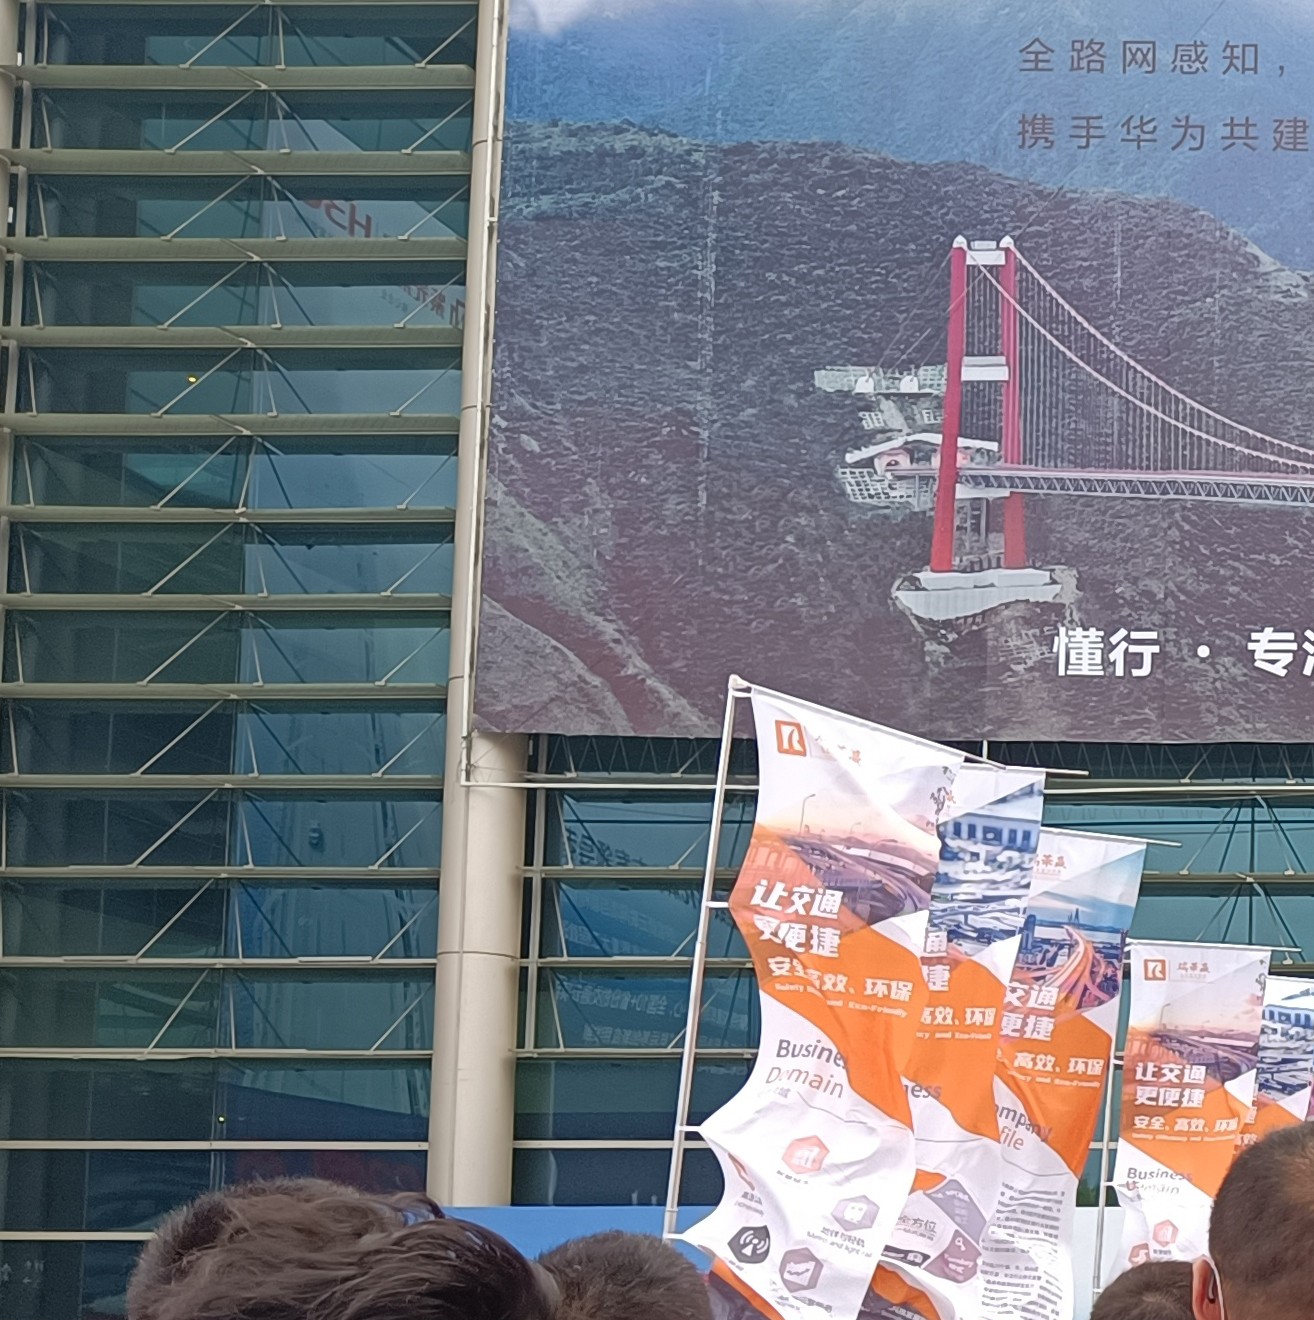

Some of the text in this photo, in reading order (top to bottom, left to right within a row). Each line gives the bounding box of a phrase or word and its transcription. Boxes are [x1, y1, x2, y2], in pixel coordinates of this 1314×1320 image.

[750, 879, 844, 919] 让交通
[1135, 1062, 1206, 1084] 让交通
[1134, 1085, 1206, 1108] 更便捷
